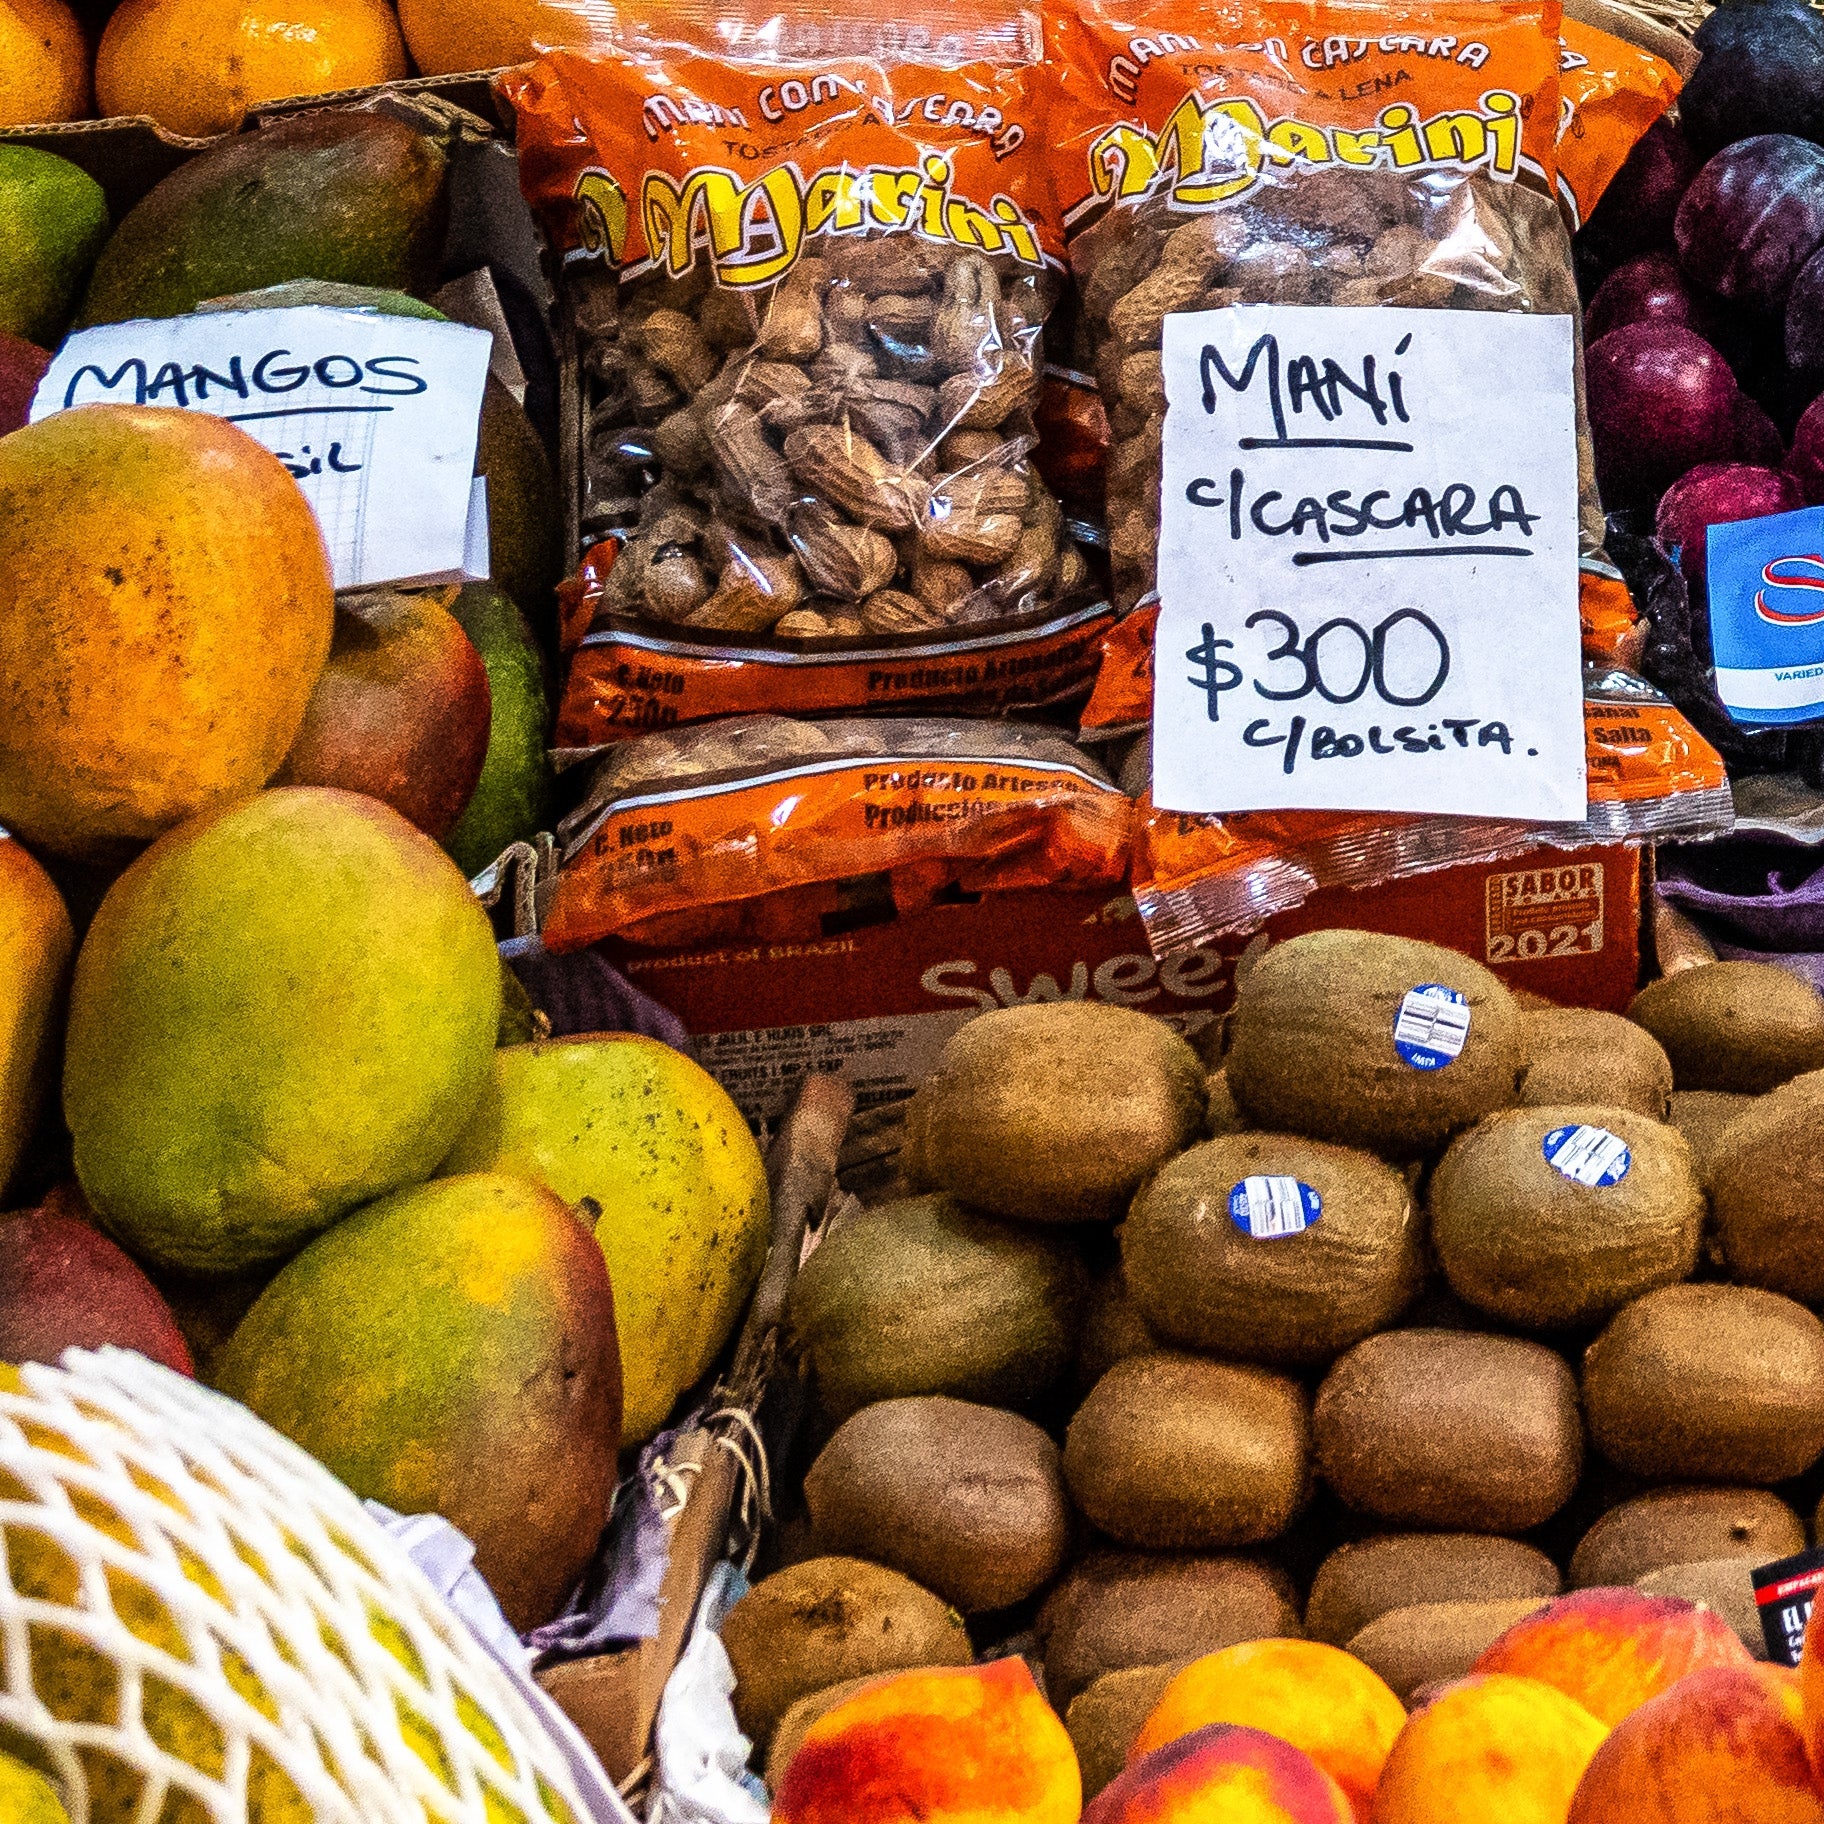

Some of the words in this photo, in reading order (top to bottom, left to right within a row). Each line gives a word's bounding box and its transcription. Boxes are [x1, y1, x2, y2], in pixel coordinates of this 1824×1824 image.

[1087, 90, 1523, 216] Marini
[573, 149, 1050, 292] Marini
[63, 349, 429, 408] MANGOS
[1185, 607, 1450, 722] $300
[1592, 722, 1653, 746] Salta
[1506, 867, 1596, 898] SABOR
[626, 954, 725, 974] product
[730, 947, 764, 966] of
[767, 940, 858, 962] BRAZIL
[1490, 920, 1603, 963] 2021
